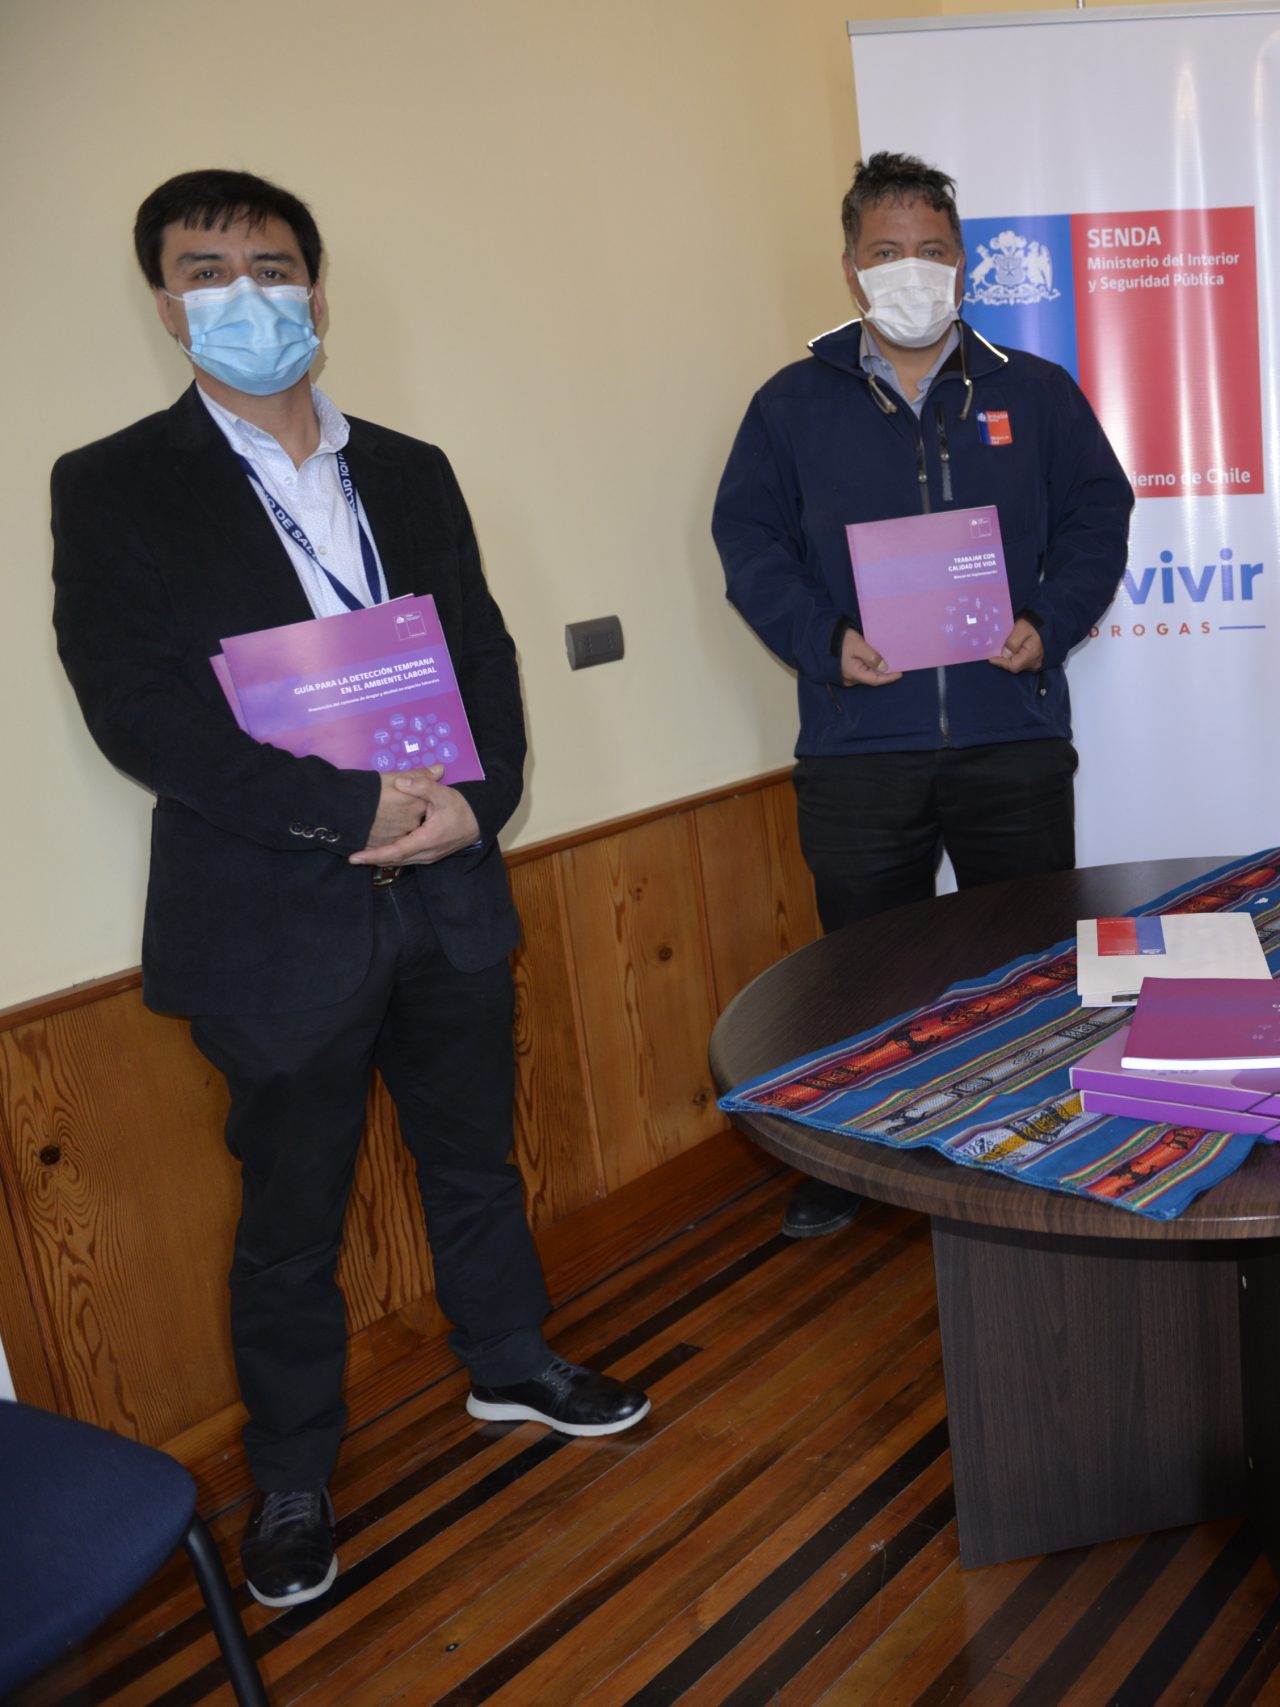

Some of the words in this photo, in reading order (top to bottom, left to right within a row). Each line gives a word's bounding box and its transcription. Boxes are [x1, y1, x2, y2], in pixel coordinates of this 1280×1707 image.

[1087, 226, 1161, 248] SENDA
[1087, 255, 1159, 270] Ministerio
[1162, 253, 1183, 267] del
[1188, 252, 1240, 266] Interior
[1088, 279, 1096, 293] y
[1100, 274, 1170, 292] Seguridad
[1173, 272, 1225, 287] Pública
[1131, 471, 1176, 487] ierno
[1206, 467, 1251, 484] Chile
[275, 509, 294, 530] DE
[982, 560, 997, 568] VIDA
[1122, 548, 1263, 605] vivir
[1088, 622, 1211, 638] DROGAS
[294, 683, 315, 695] GUÍA
[315, 680, 337, 690] PARA
[338, 677, 349, 686] LA
[349, 667, 393, 683] DETECCIÓN
[394, 657, 435, 673] TEMPRANA
[340, 686, 352, 695] EN
[353, 684, 363, 692] EL
[364, 674, 403, 690] AMBIENTE
[403, 666, 437, 680] LABORAL
